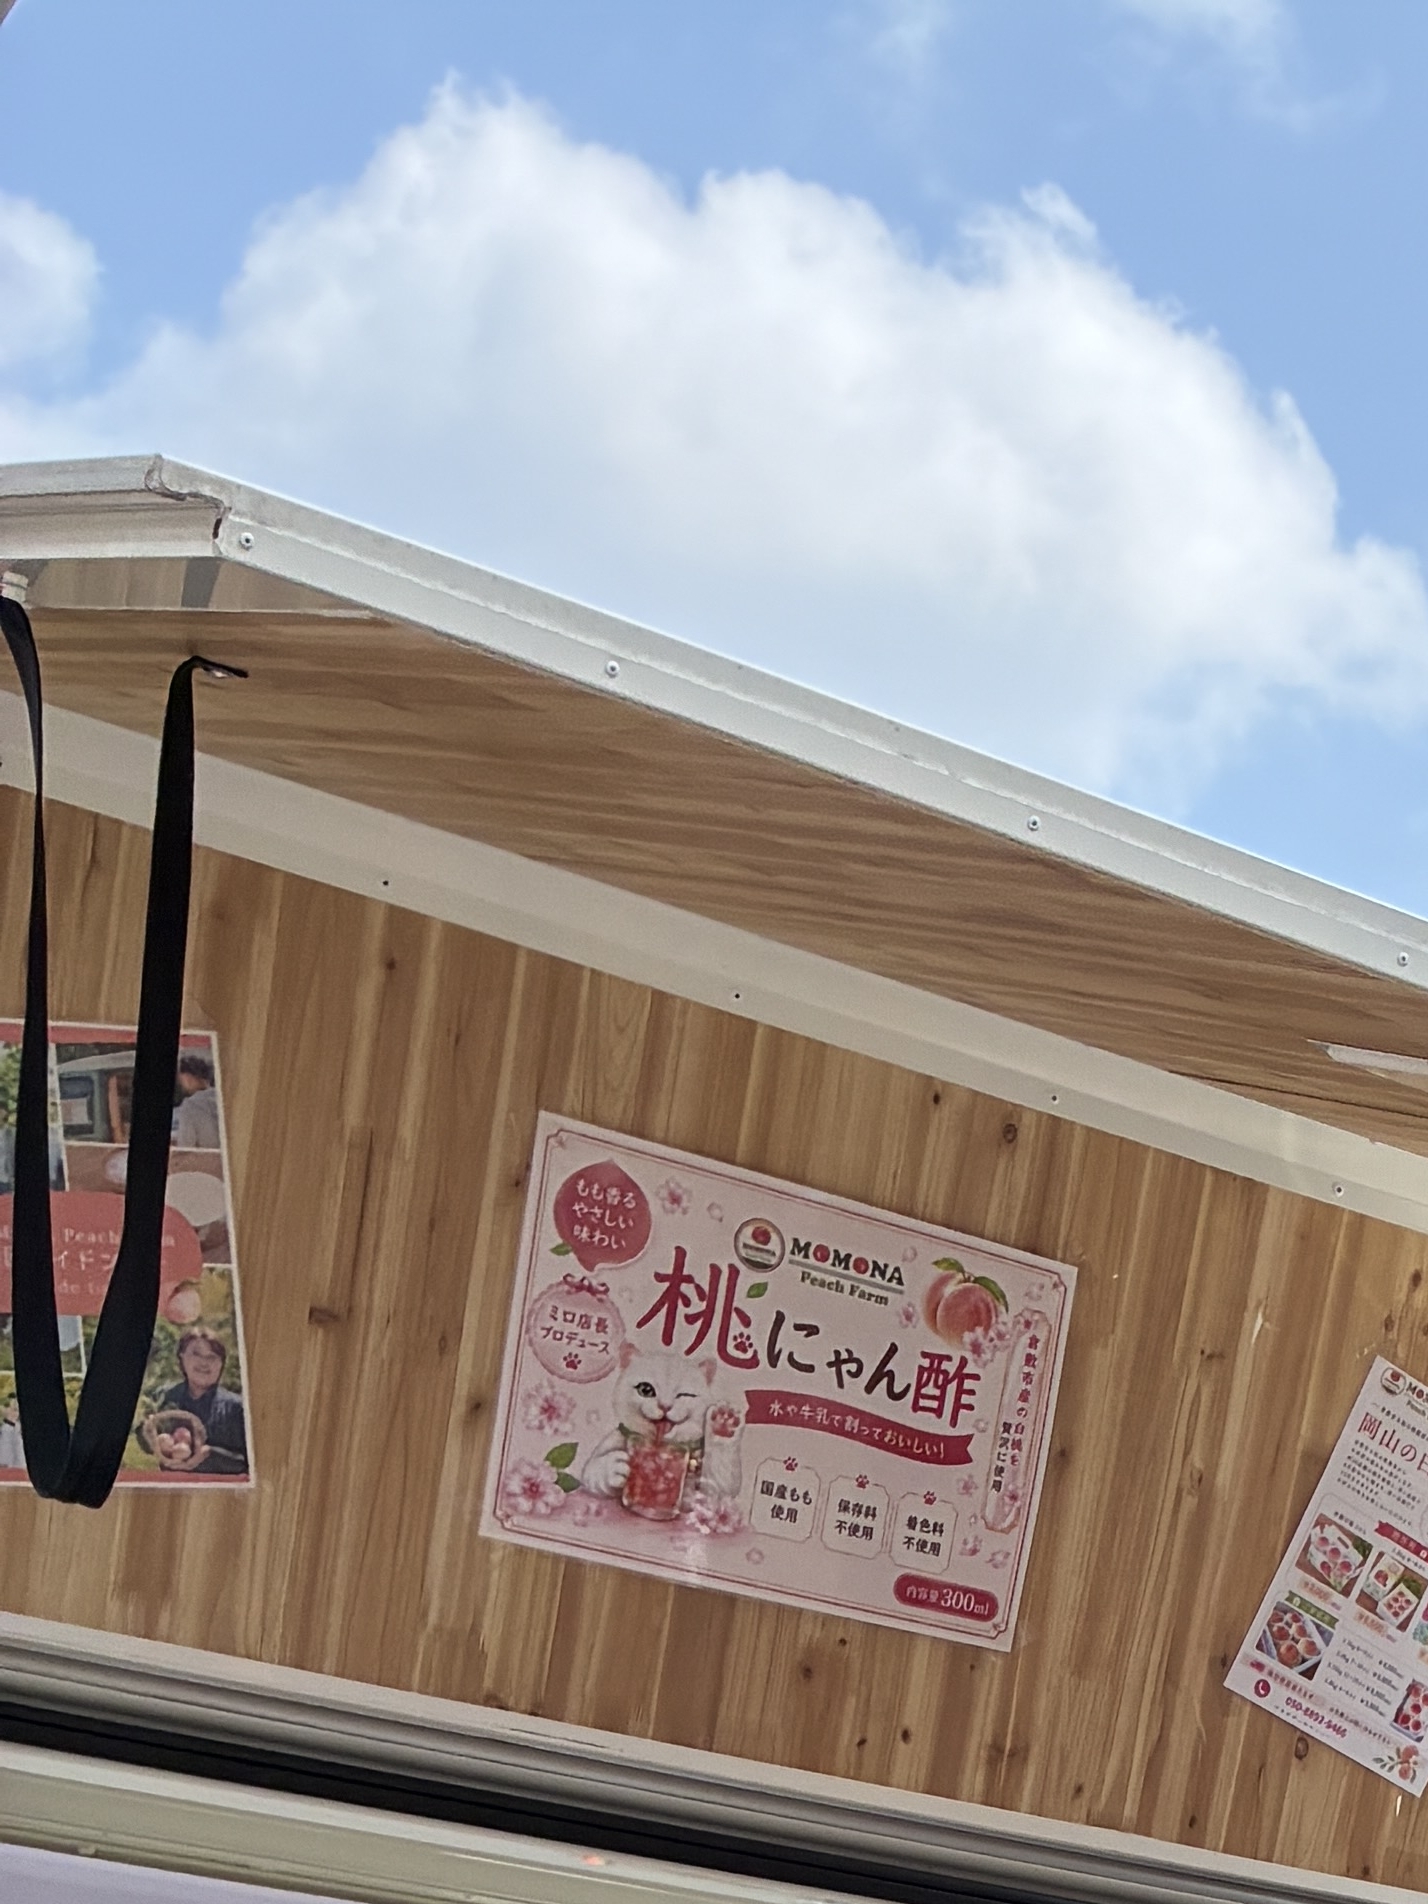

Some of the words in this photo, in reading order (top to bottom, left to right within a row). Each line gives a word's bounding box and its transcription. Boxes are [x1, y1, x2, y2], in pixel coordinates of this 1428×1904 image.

[575, 1178, 638, 1210] もも香る
[572, 1200, 634, 1229] やさしい
[573, 1225, 627, 1250] 味わい
[789, 1237, 905, 1287] MOMONA
[799, 1269, 845, 1297] Peach
[848, 1279, 890, 1308] Farm
[548, 1306, 610, 1335] ミロ店長
[540, 1325, 611, 1355] プロデュース
[636, 1246, 981, 1428] 桃にゃん酢
[760, 1478, 813, 1506] 国産もも
[769, 1503, 799, 1523] 使用
[836, 1498, 878, 1521] 保存料
[834, 1520, 873, 1541] 不使用
[905, 1514, 945, 1538] 着色料
[902, 1534, 942, 1558] 不使用
